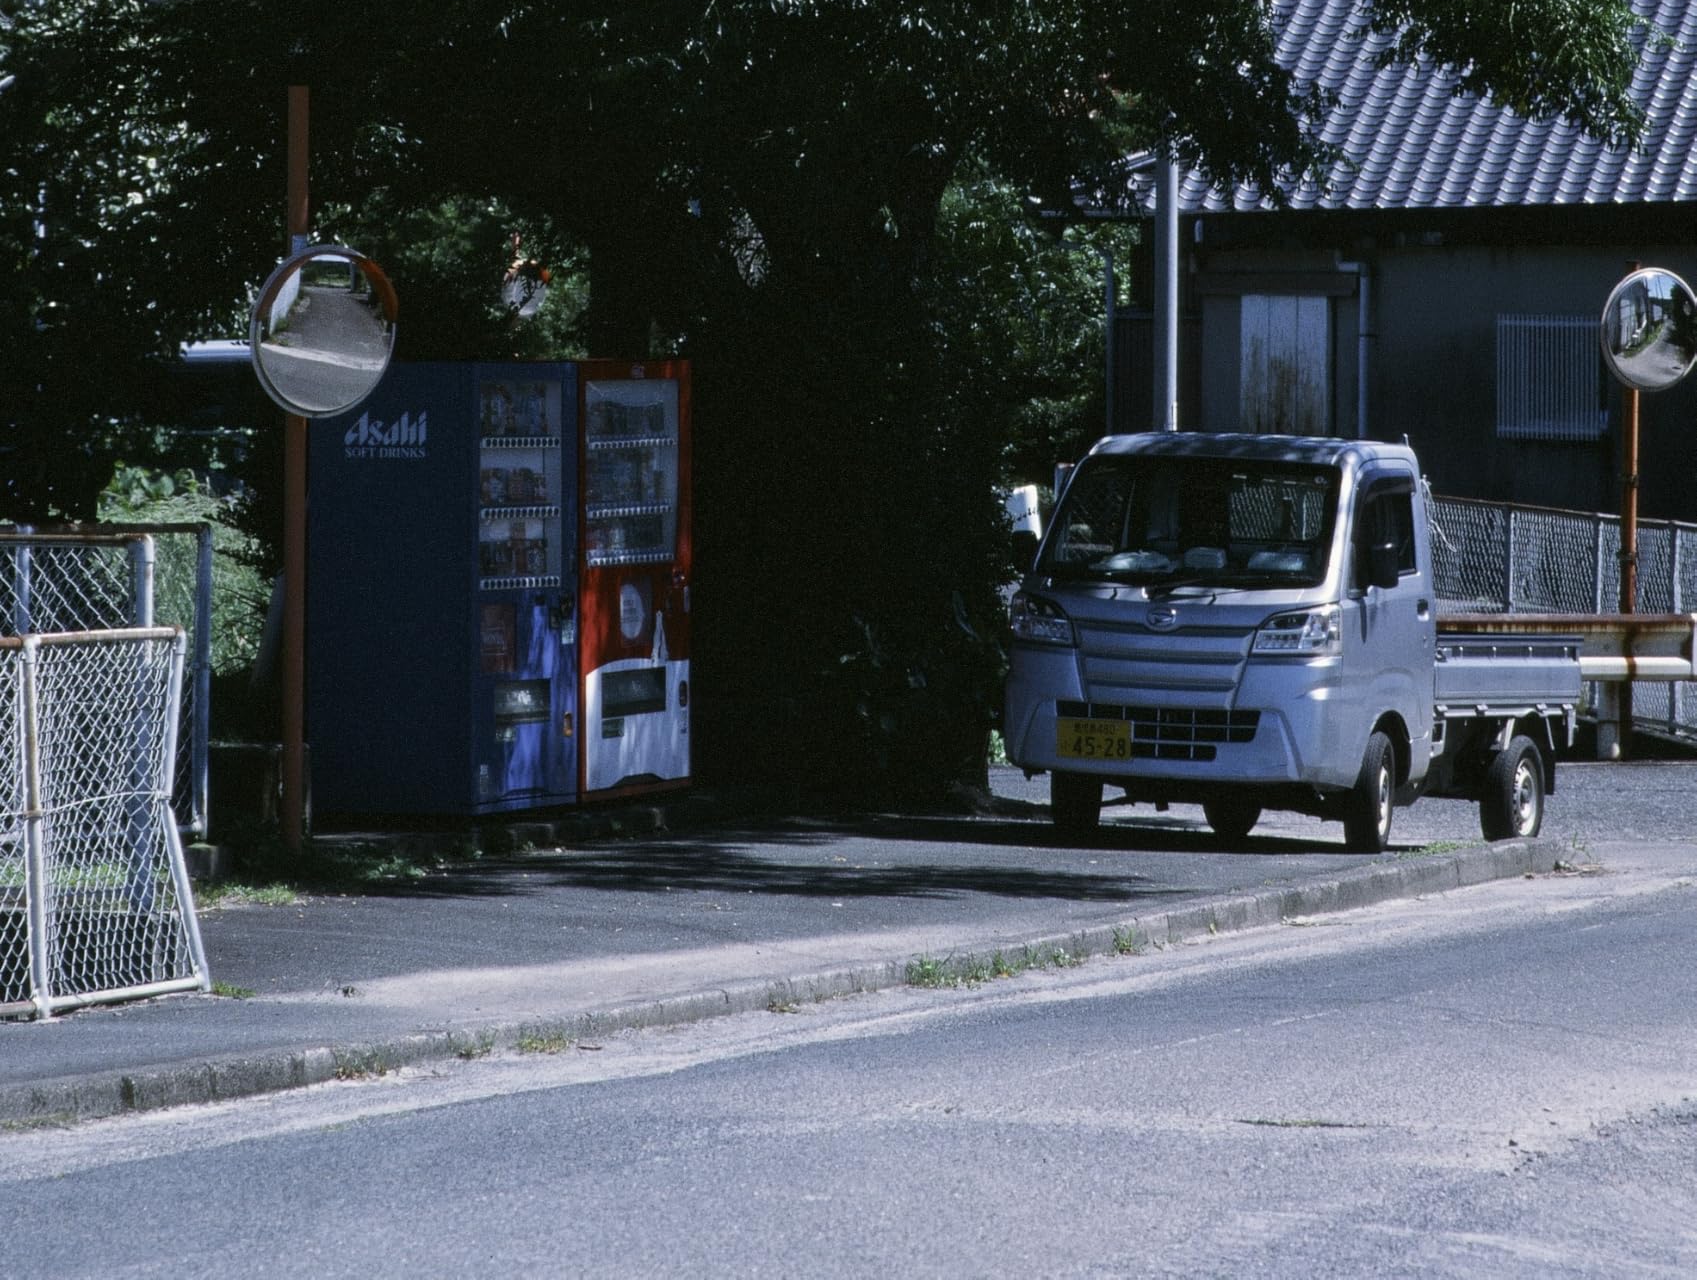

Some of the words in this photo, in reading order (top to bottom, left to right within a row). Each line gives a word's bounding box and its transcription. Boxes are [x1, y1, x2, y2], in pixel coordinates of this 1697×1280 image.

[344, 411, 427, 446] Asahi
[344, 447, 376, 458] SOFT
[379, 447, 426, 458] DRINKS
[1072, 736, 1126, 757] 45-28
